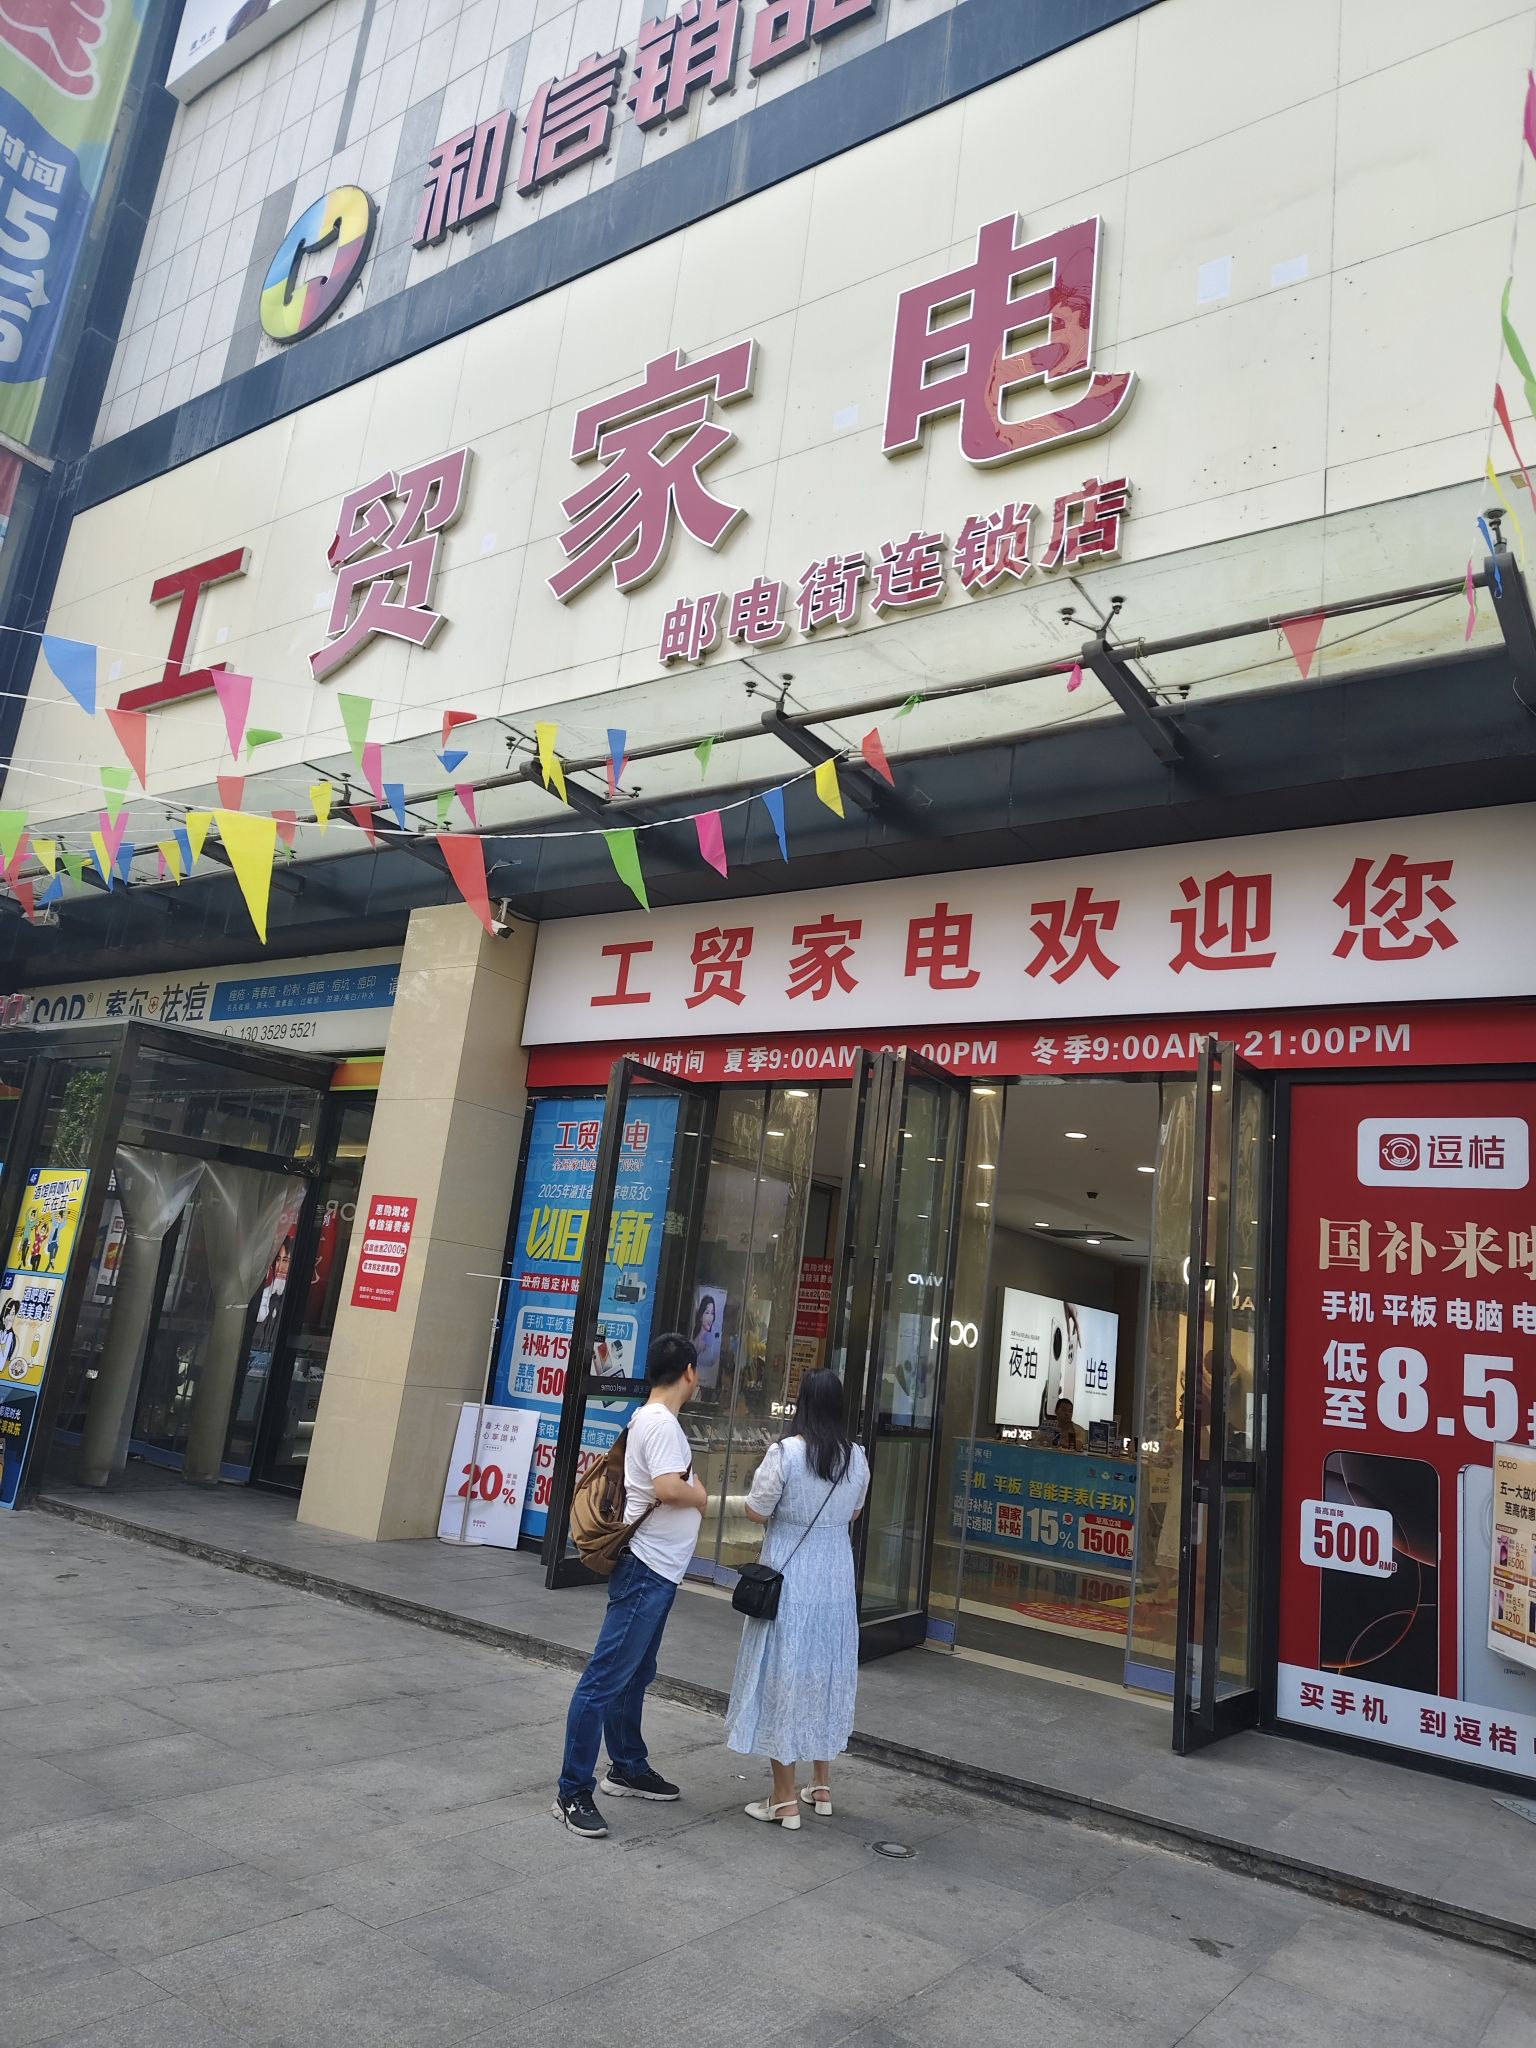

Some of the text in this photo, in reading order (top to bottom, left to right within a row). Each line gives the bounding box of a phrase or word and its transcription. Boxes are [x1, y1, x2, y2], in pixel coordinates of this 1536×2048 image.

[117, 211, 1139, 711] 工贸家电
[657, 475, 1134, 668] 邮电街连锁店
[589, 853, 1459, 1010] 工贸家电欢迎您
[160, 980, 210, 1023] 祛痘
[240, 1021, 317, 1041] 130 3529 5521
[554, 1119, 650, 1152] 工贸电
[1426, 1134, 1506, 1170] 逗桔
[526, 1314, 545, 1329] 手机
[546, 1316, 564, 1331] 平板
[1321, 1290, 1375, 1324] 手机
[1382, 1294, 1437, 1329] 平板
[1446, 1297, 1503, 1334] 电脑
[515, 1376, 535, 1394] 补贴
[1009, 1344, 1109, 1390] 夜拍 出色
[960, 1469, 988, 1490] 手机
[993, 1475, 1023, 1496] 平板
[1027, 1479, 1136, 1516] 智能手表(手环)
[1314, 1506, 1344, 1518] 最高直降
[997, 1520, 1022, 1537] 补贴
[998, 1505, 1023, 1523] 国家
[1314, 1518, 1380, 1567] 500
[1378, 1560, 1397, 1572] RMB
[1300, 1681, 1389, 1725] 买手机
